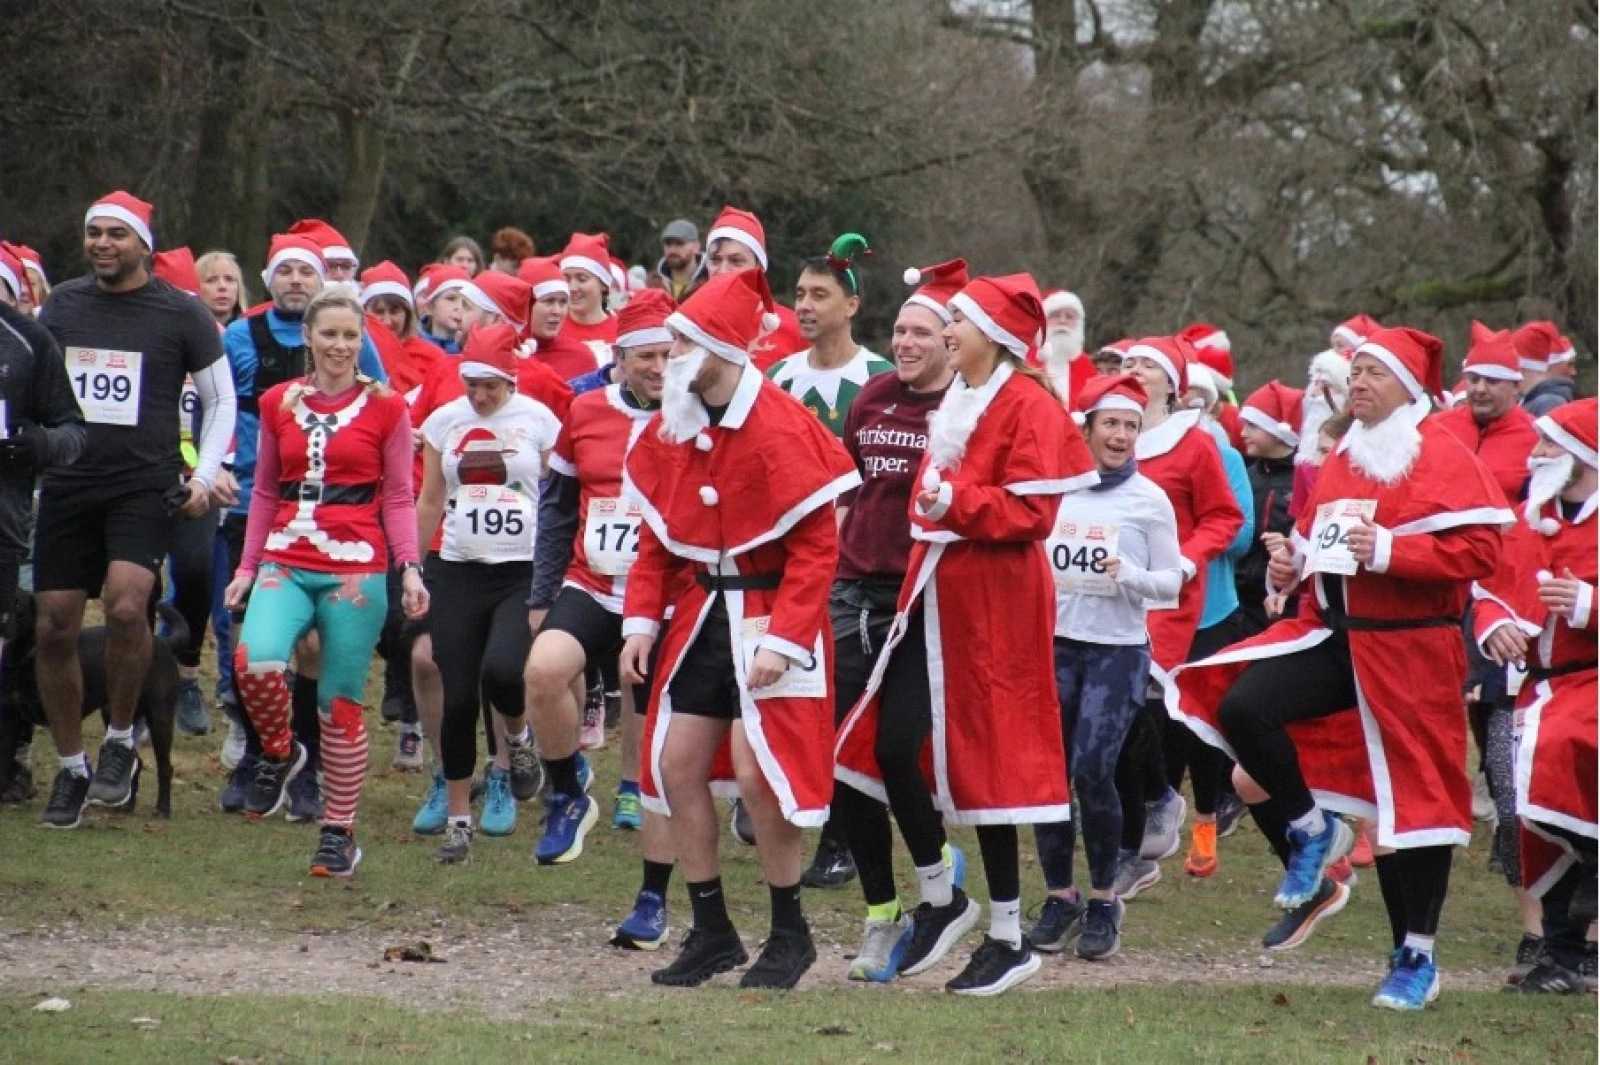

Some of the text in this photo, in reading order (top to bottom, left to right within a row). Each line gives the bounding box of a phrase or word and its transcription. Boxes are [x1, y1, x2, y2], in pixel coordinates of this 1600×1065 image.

[75, 372, 131, 402] 199
[465, 507, 524, 536] 195
[1053, 544, 1108, 574] 048
